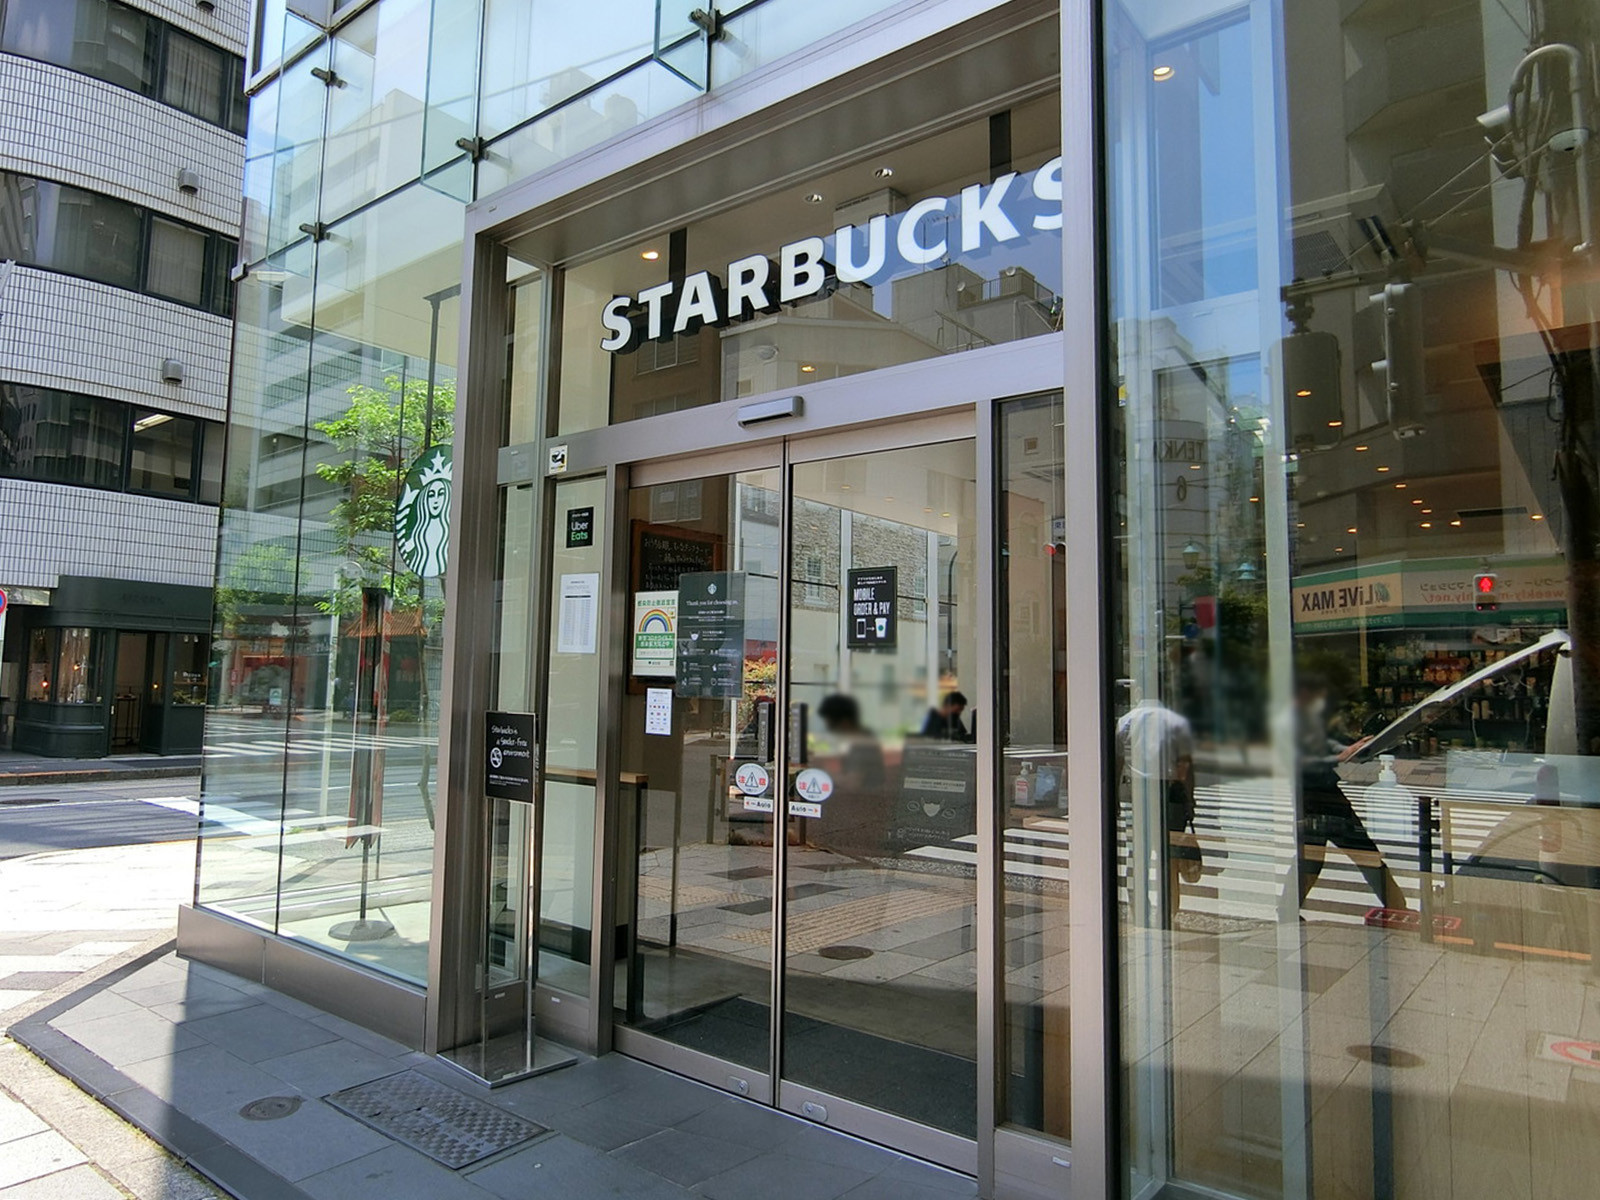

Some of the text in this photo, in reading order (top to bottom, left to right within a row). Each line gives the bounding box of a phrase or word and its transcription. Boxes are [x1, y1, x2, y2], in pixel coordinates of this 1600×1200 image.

[601, 156, 1063, 352] STARBUCKS
[571, 521, 588, 531] Uber
[571, 531, 588, 541] Eats
[853, 587, 875, 602] MOBILE
[853, 601, 891, 616] ORDER & PAY
[756, 799, 771, 809] Auto
[790, 804, 807, 813] Auto
